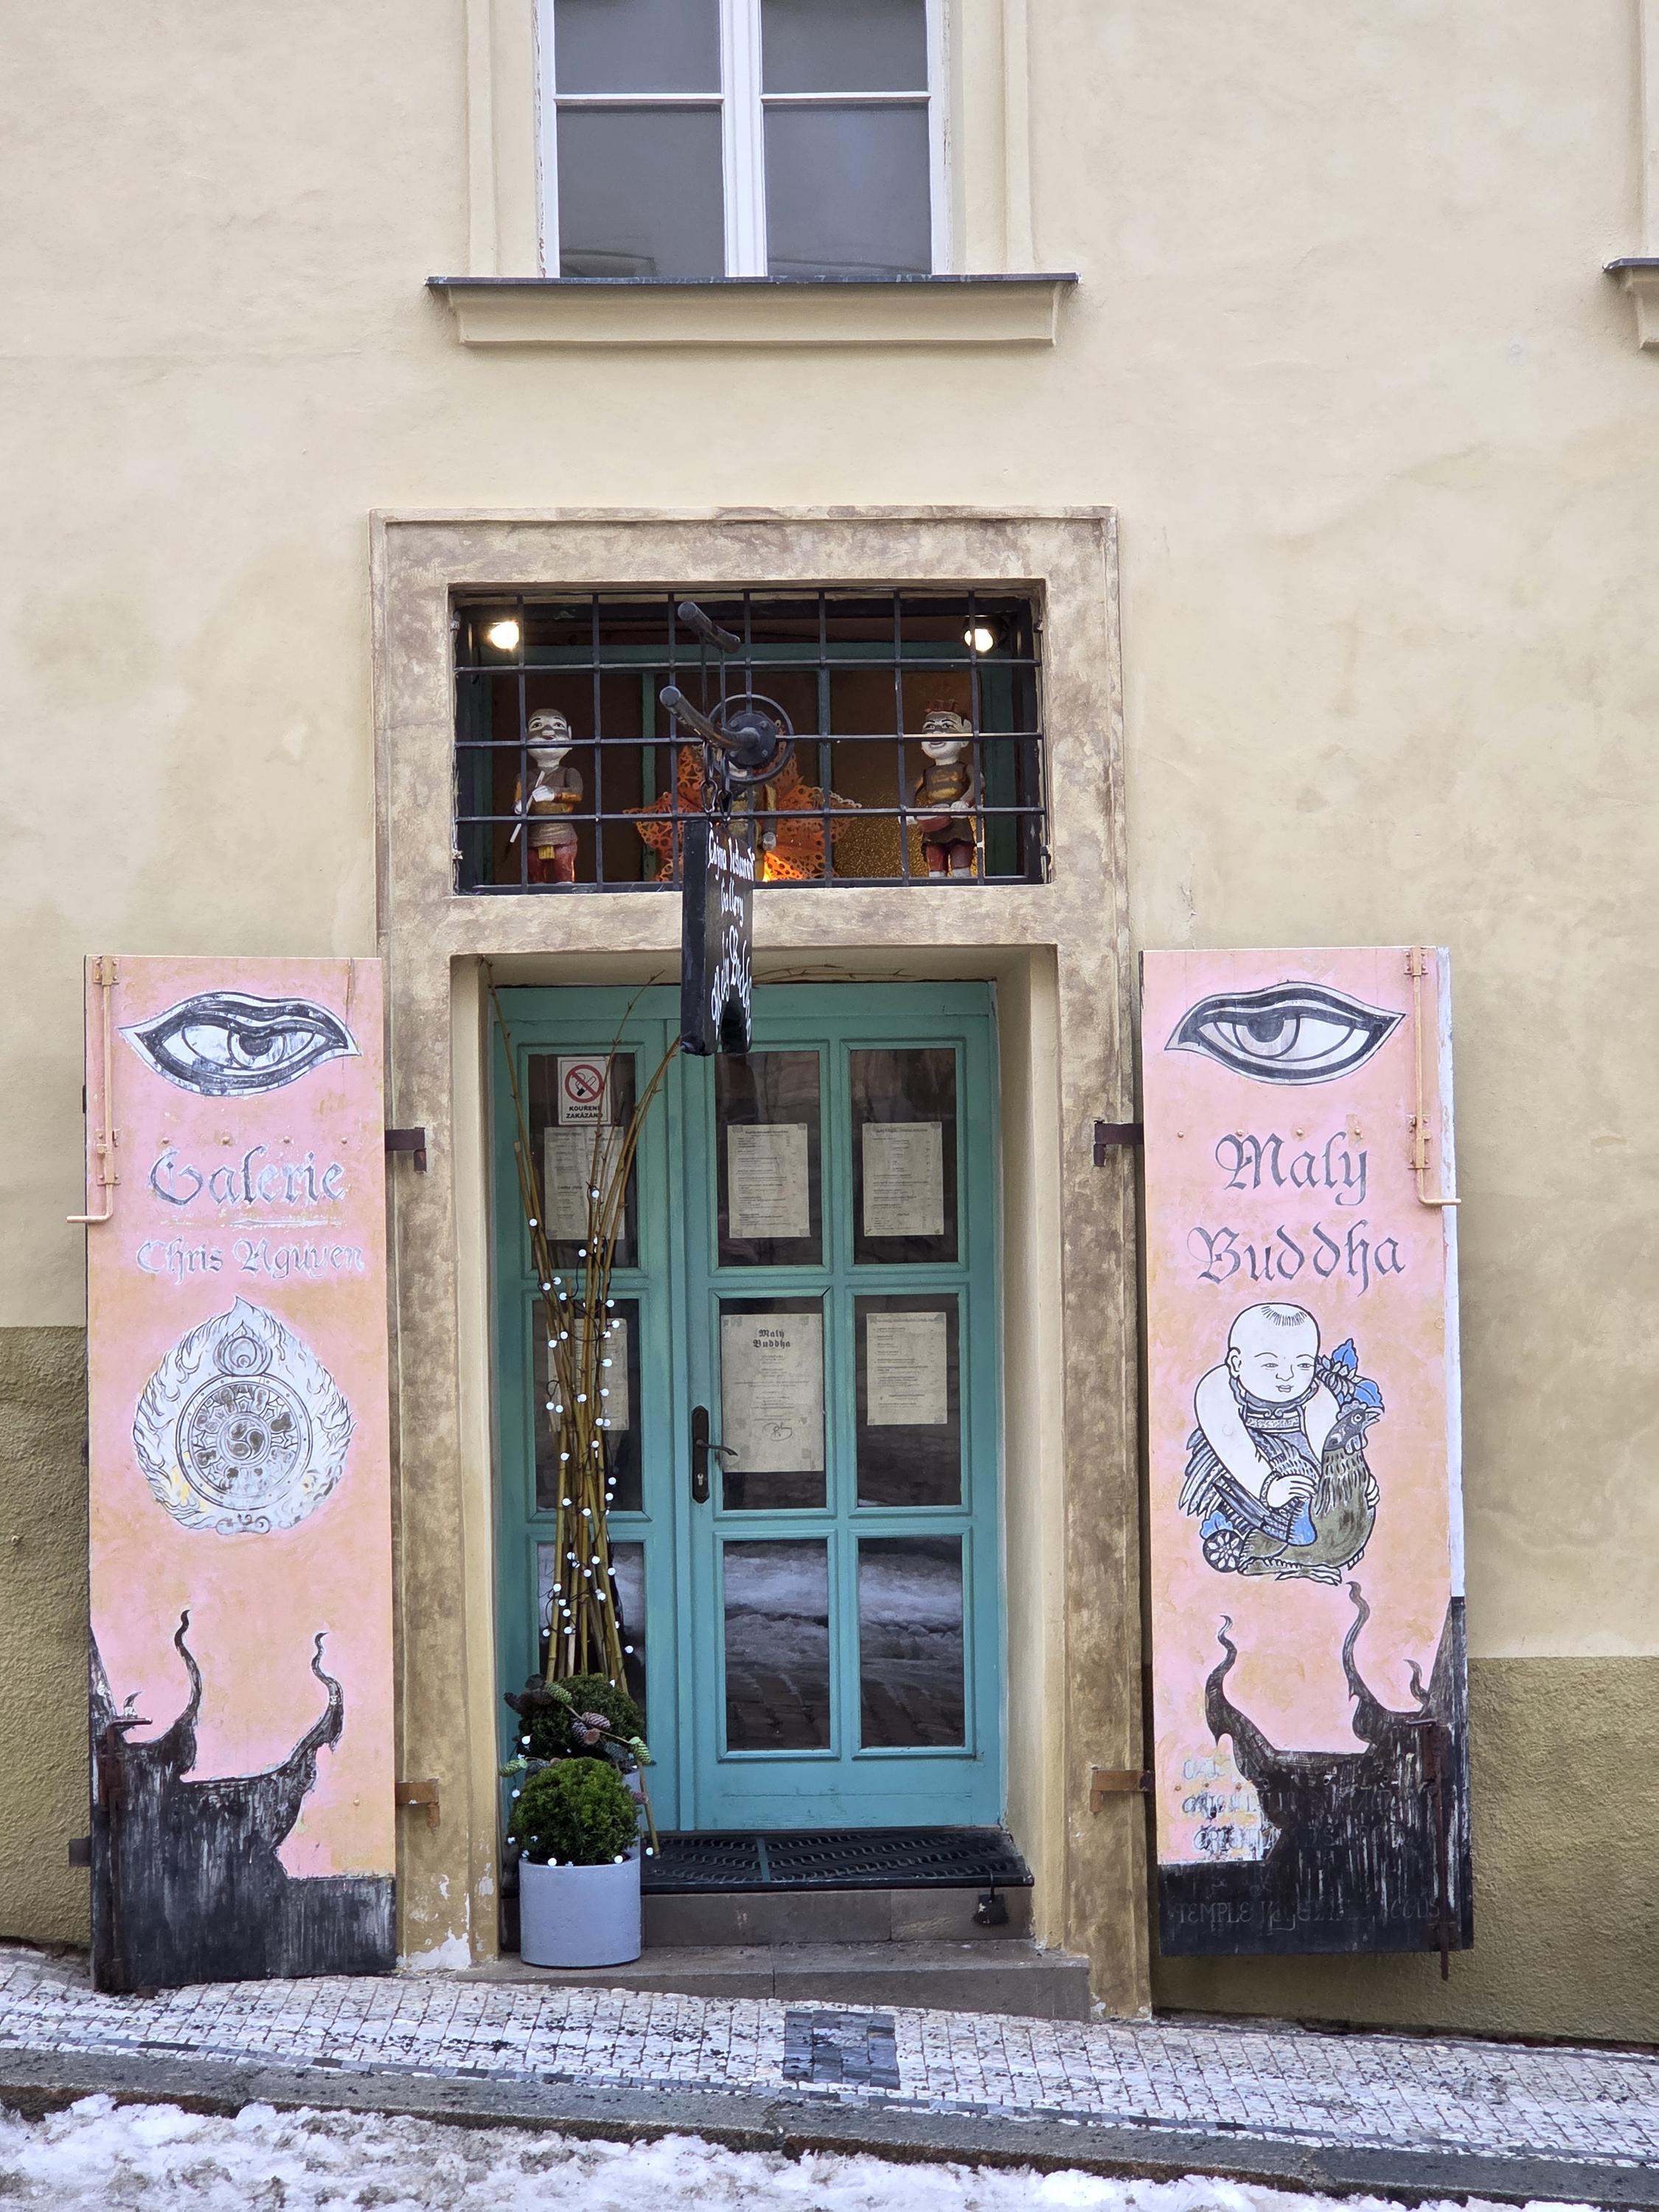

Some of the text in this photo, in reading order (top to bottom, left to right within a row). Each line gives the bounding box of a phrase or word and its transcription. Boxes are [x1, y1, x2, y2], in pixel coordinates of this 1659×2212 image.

[149, 1145, 347, 1206] Galerie
[136, 1235, 366, 1285] Chris Nguyen
[1186, 1219, 1406, 1297] Buddha
[753, 1339, 791, 1349] Buddha
